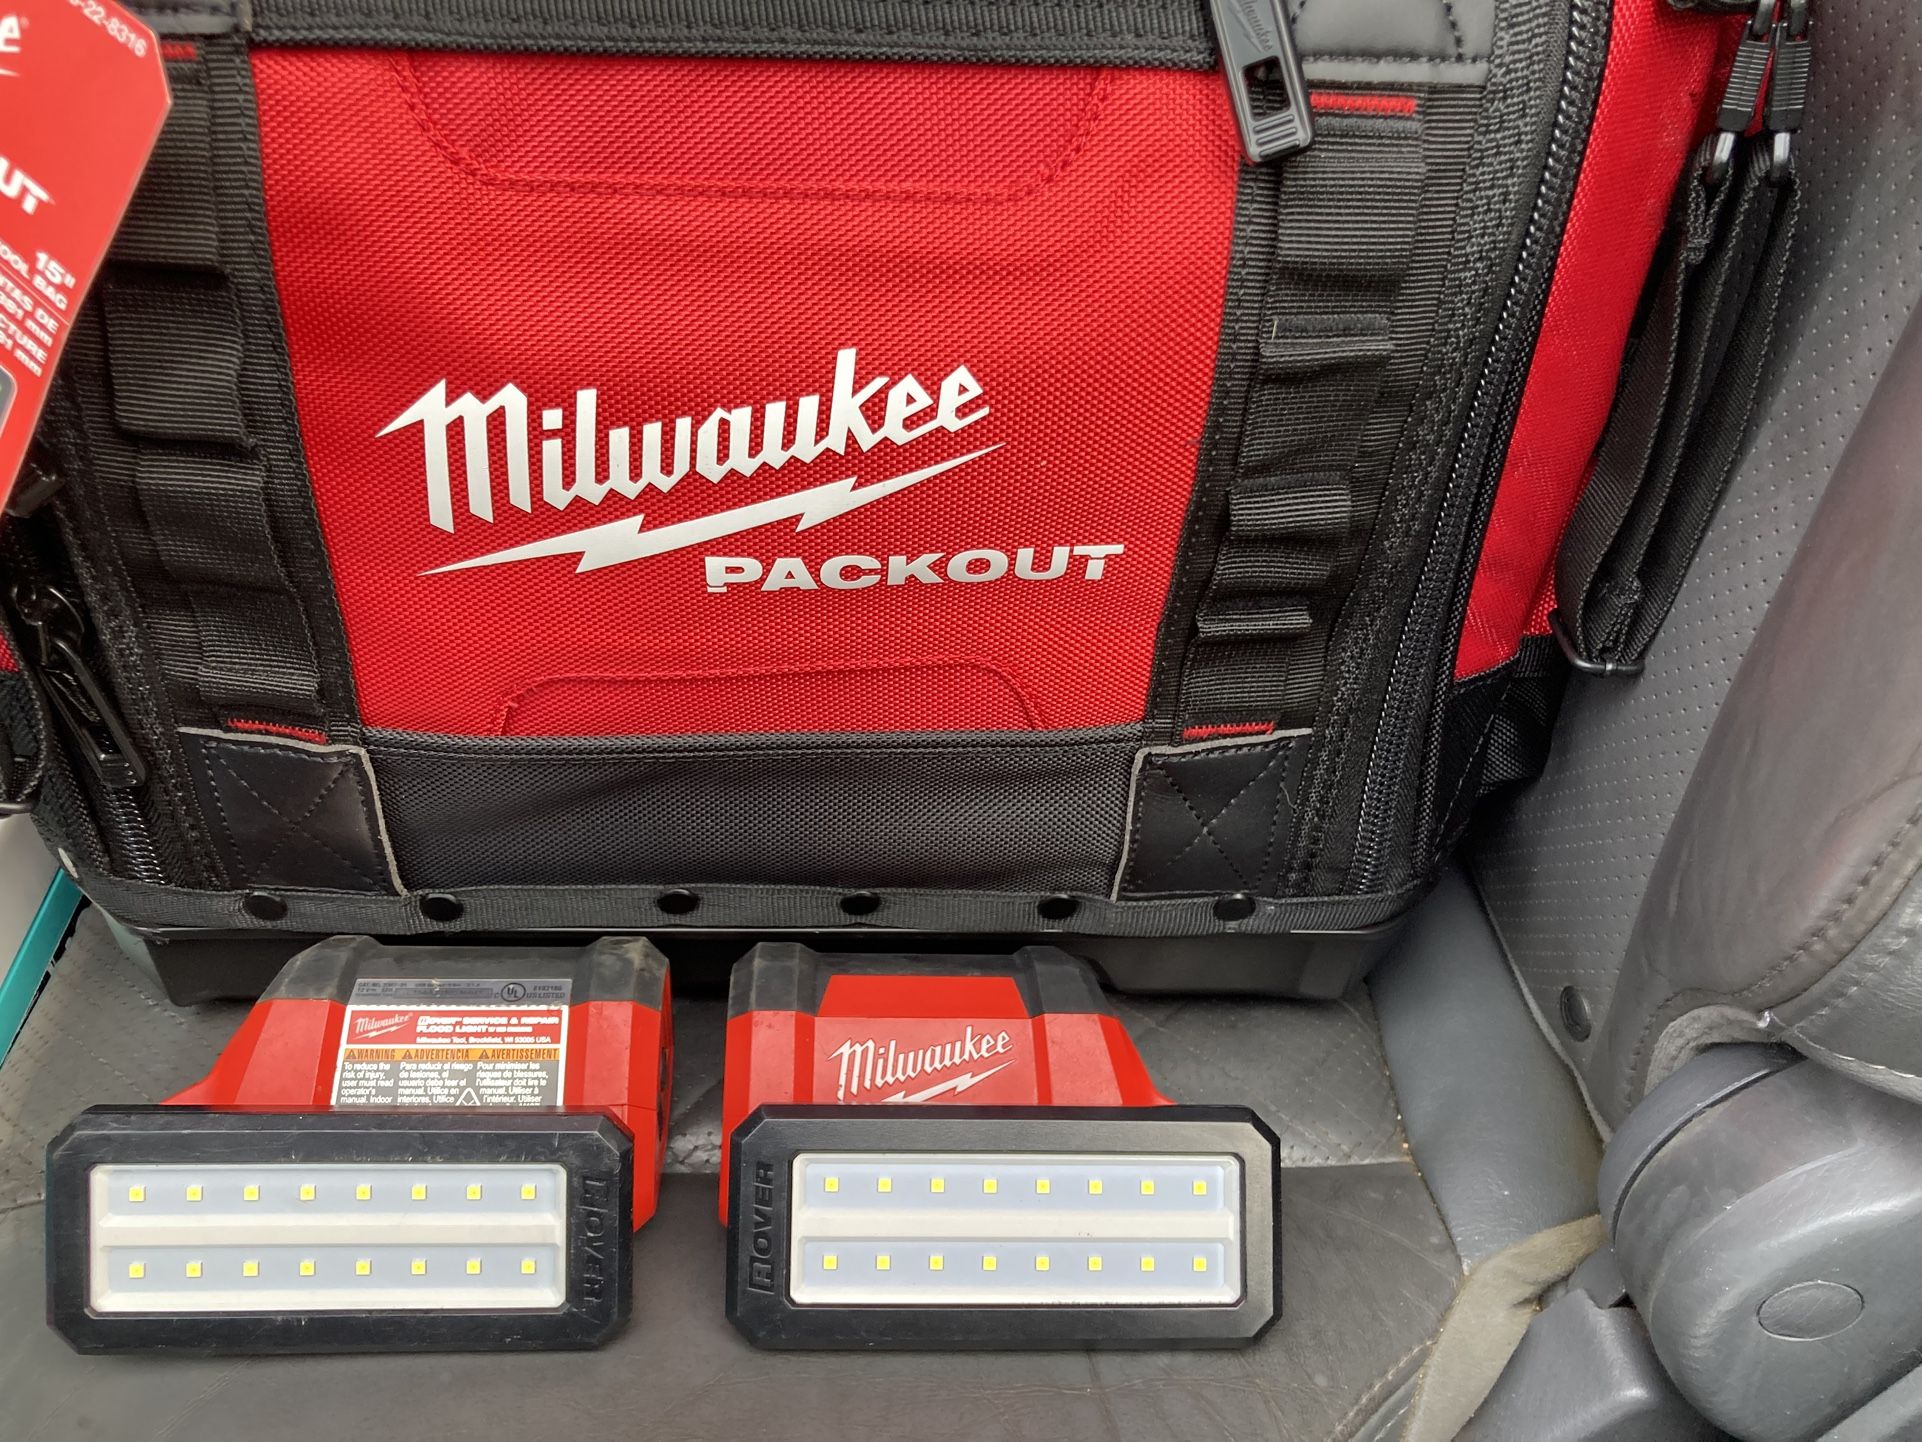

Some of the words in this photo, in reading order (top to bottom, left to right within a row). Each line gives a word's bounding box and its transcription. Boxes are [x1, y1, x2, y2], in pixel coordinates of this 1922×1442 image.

[32, 274, 68, 311] BAG
[34, 307, 59, 335] DE
[25, 319, 53, 347] mm
[14, 347, 42, 377] mm
[375, 348, 991, 534] Milwaukee
[704, 543, 1125, 594] PACKOUT
[352, 1013, 409, 1034] Milwaukee
[357, 1049, 396, 1060] WARNING
[414, 1049, 470, 1060] ADVERTENCIA
[491, 1048, 557, 1060] AVERTISSEMENT
[344, 1062, 352, 1070] To
[353, 1062, 378, 1070] reduce
[379, 1062, 390, 1070] the
[400, 1062, 417, 1070] Para
[418, 1062, 442, 1070] reducir
[451, 1062, 473, 1071] riesgo
[827, 1025, 1014, 1104] Milwaukee
[342, 1070, 355, 1078] risk
[356, 1070, 364, 1078] of
[399, 1070, 409, 1078] de
[503, 1070, 512, 1078] de
[359, 1079, 376, 1087] must
[377, 1078, 394, 1087] read
[426, 1078, 443, 1087] debe
[513, 1078, 527, 1086] doit
[341, 1087, 376, 1096] operator's
[370, 1095, 393, 1103] Indoor
[748, 1160, 775, 1294] ROVER
